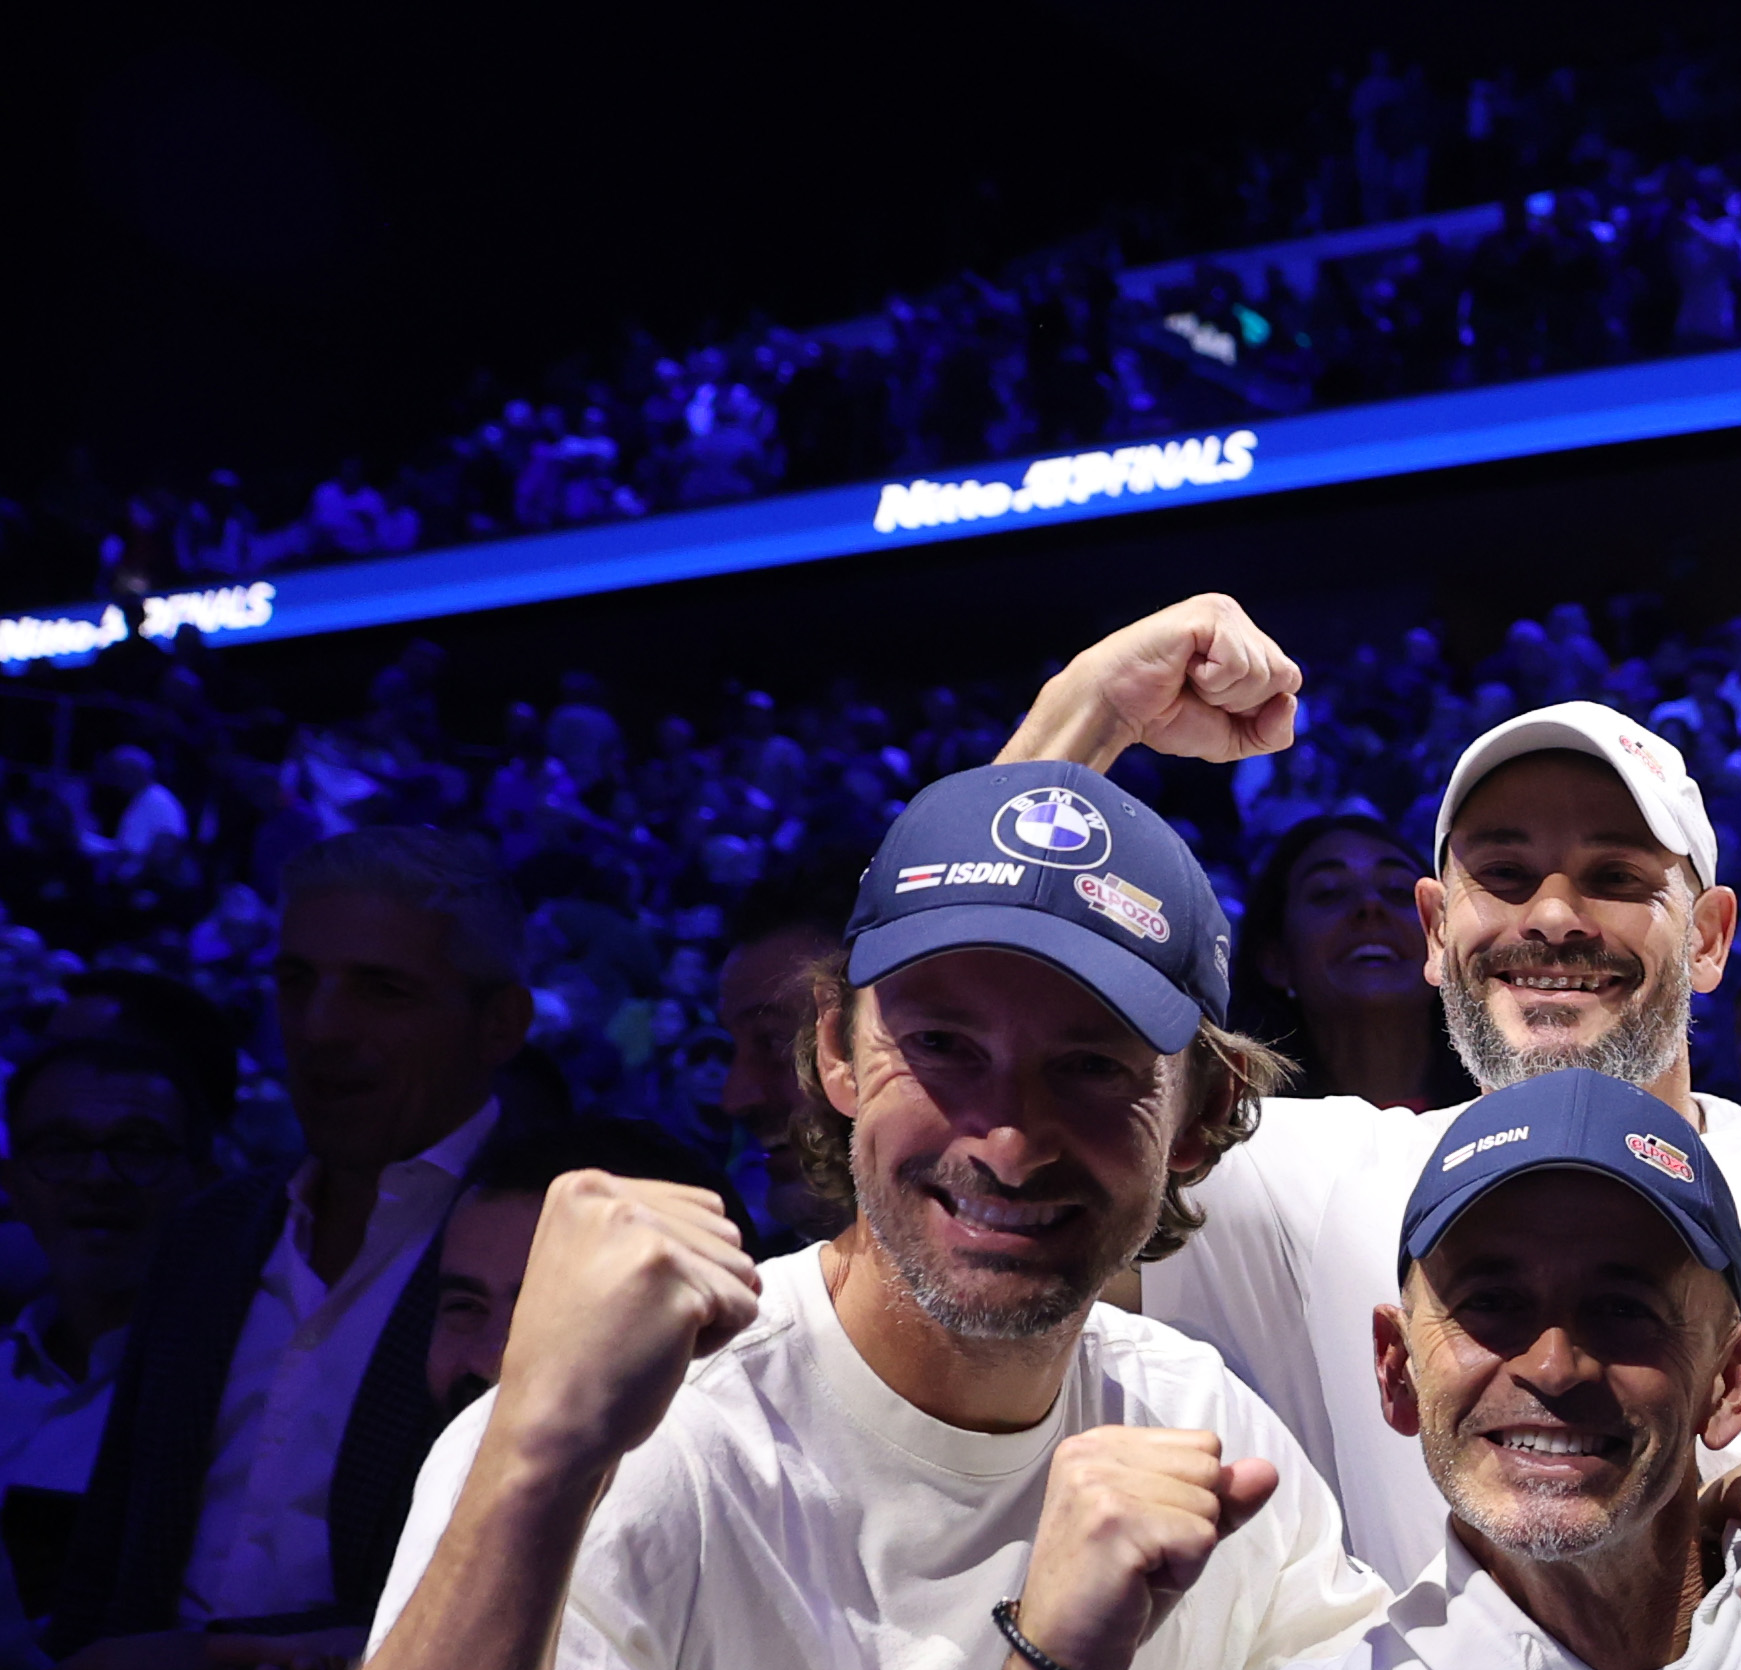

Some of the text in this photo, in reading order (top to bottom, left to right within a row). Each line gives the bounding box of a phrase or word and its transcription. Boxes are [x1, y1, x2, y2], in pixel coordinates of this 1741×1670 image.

[873, 479, 1014, 533] Nitto
[1010, 790, 1104, 830] BMW
[945, 862, 1025, 886] ISDIN
[1476, 1126, 1530, 1152] ISDIN
